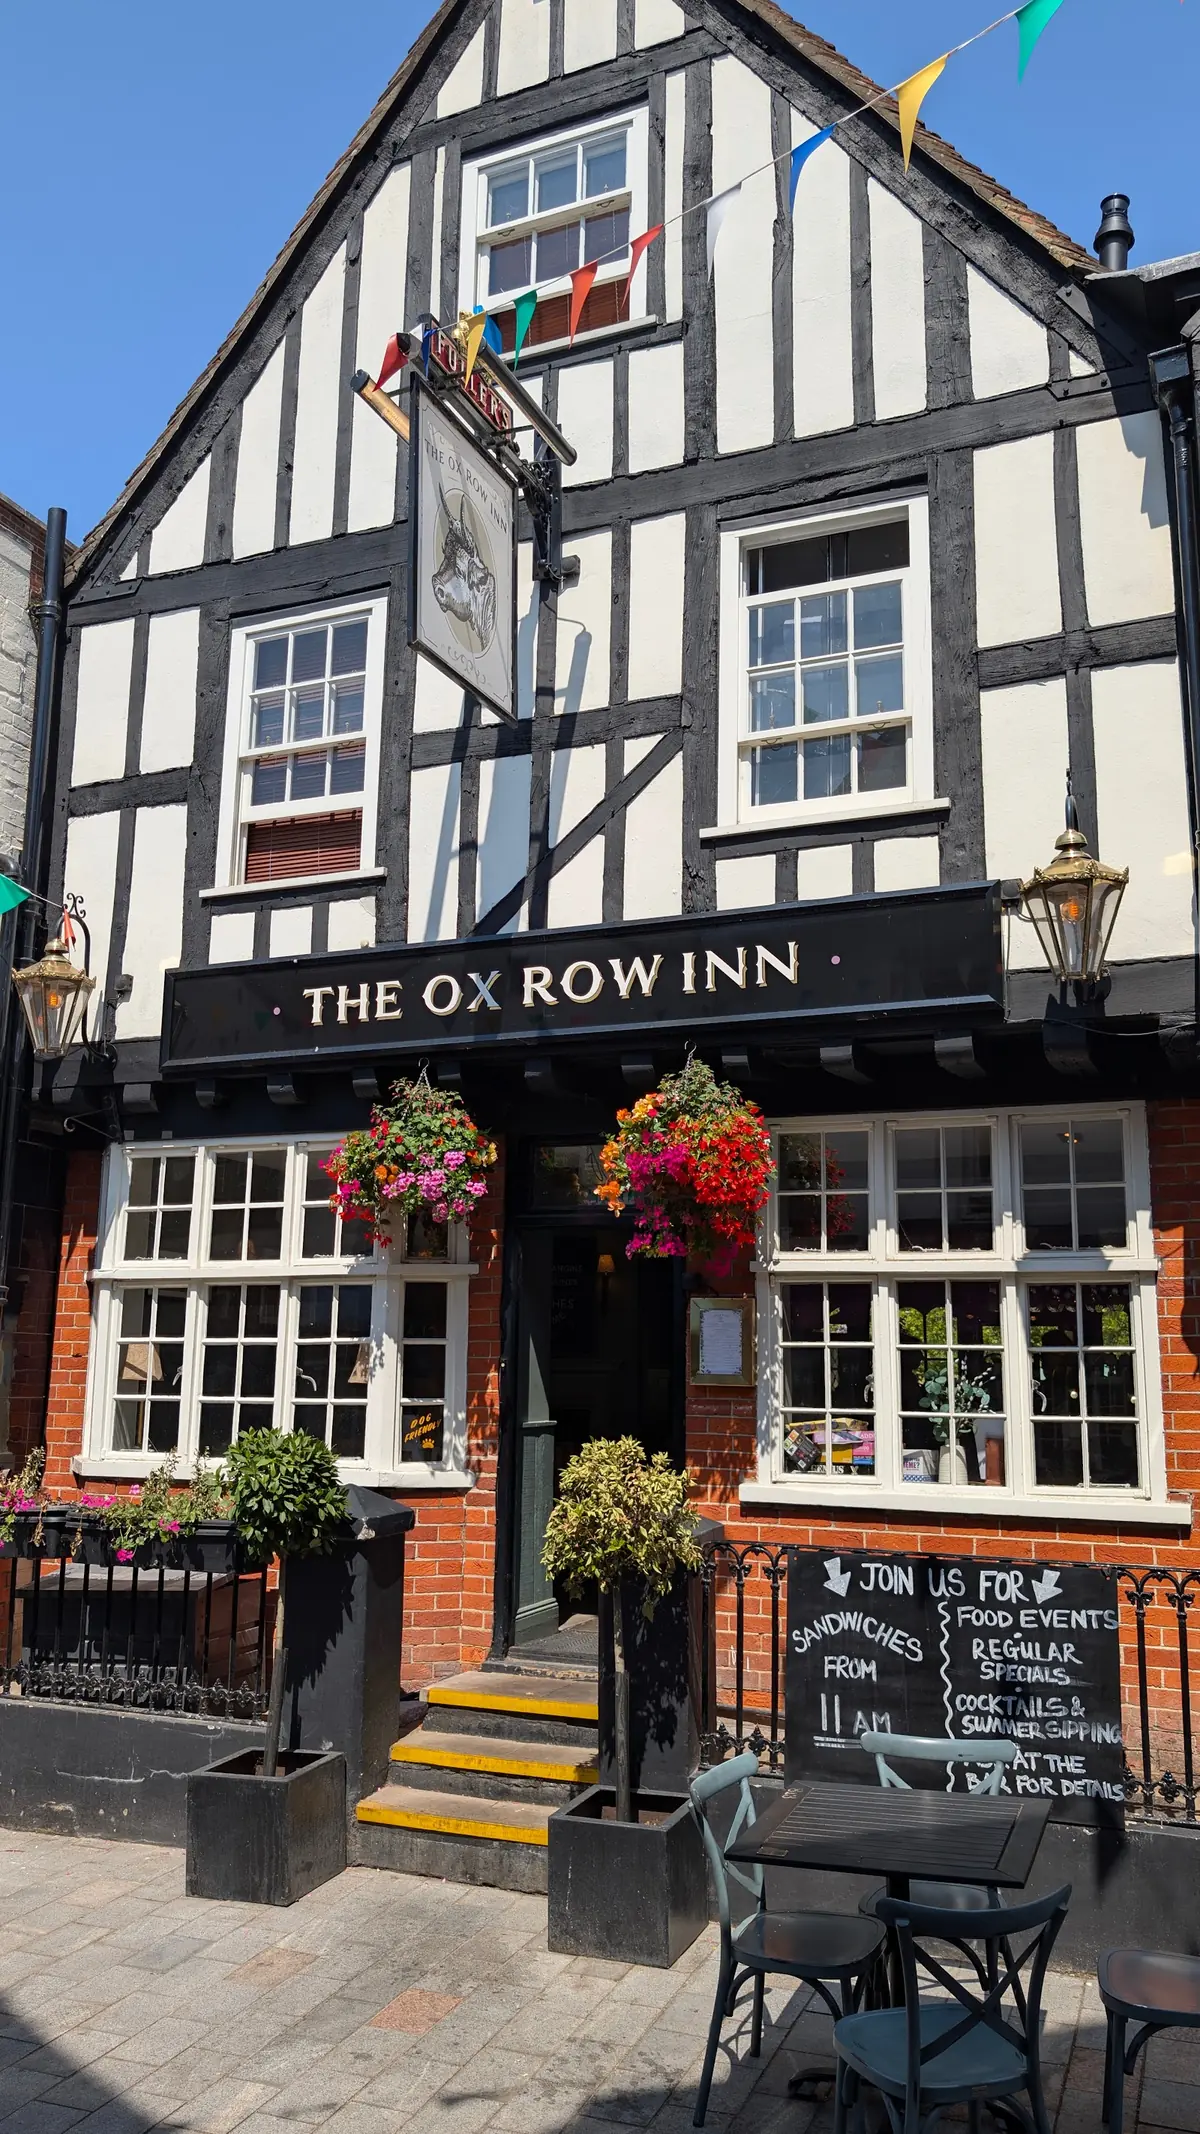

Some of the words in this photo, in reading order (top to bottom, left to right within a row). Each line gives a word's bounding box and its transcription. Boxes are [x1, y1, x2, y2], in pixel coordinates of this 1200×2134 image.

[424, 439, 445, 465] THE
[448, 456, 463, 476] OX
[466, 469, 488, 503] ROW
[490, 503, 508, 534] INN
[303, 980, 403, 1027] THE
[422, 970, 502, 1017] OX
[522, 954, 664, 1008] ROW
[682, 941, 799, 995] INN
[404, 1419, 442, 1443] FRIENDLY
[410, 1413, 432, 1429] DOG
[859, 1563, 914, 1596] JOIN
[928, 1568, 966, 1597] US
[979, 1570, 1030, 1602] FOR
[957, 1606, 1014, 1628] FOOD
[1019, 1608, 1120, 1630] EVENTS
[792, 1611, 923, 1662] SANDWICHES
[972, 1637, 1083, 1664] REGULAR
[824, 1655, 877, 1682] FROM
[979, 1661, 1070, 1685] SPECIALS
[955, 1693, 1069, 1718] COCKTAILS
[1070, 1695, 1086, 1718] &
[852, 1710, 892, 1735] AM
[961, 1714, 1046, 1740] SUMMER
[1045, 1720, 1122, 1744] SIPPING
[1012, 1749, 1043, 1771] AT
[1042, 1753, 1087, 1774] THE
[1015, 1774, 1059, 1796] FOR
[1060, 1778, 1125, 1802] DETAILS
